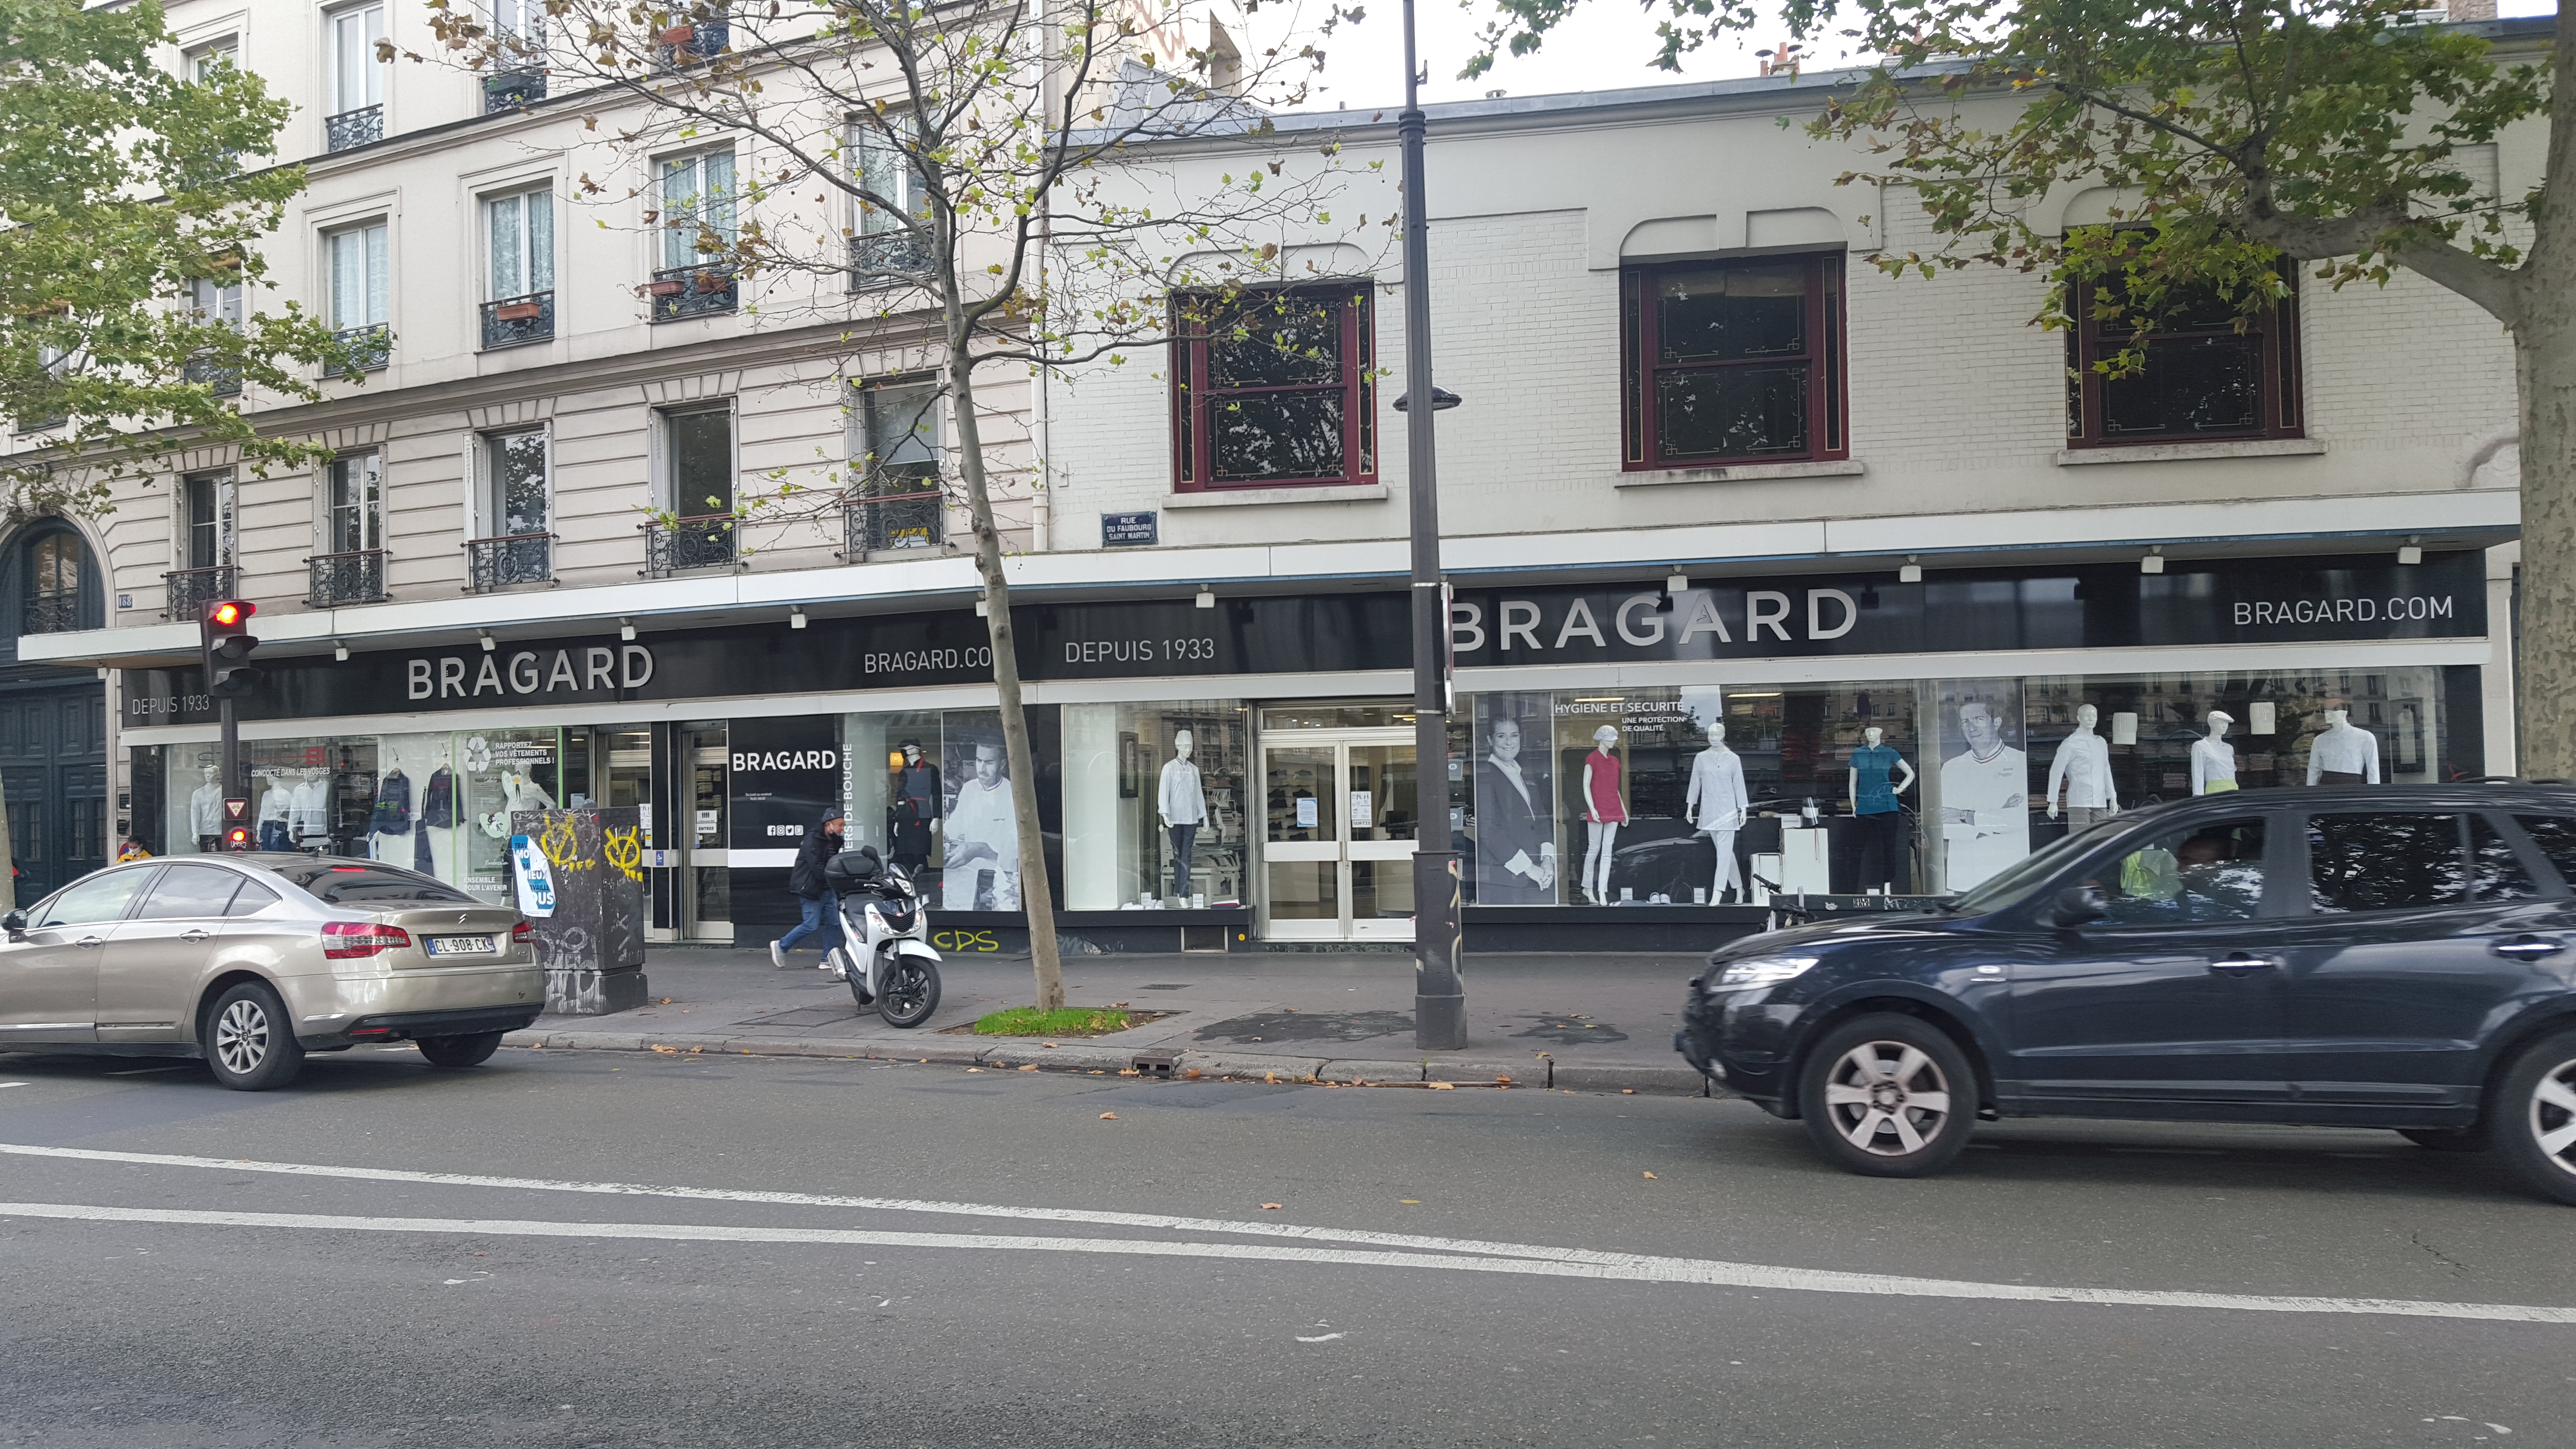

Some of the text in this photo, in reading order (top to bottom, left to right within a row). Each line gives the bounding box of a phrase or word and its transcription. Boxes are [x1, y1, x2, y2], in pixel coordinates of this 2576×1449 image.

[1117, 524, 1152, 532] FAUBOURG
[119, 596, 131, 606] 188
[2234, 596, 2452, 625] BRAGARD.COM
[1451, 588, 1857, 652] BRAGARD
[865, 646, 991, 673] BRAGARD.CO
[1066, 638, 1214, 662] DEPUIS 1933
[408, 645, 653, 699] BRAGARD
[132, 694, 209, 715] DEPUIS 1933
[1555, 703, 1608, 713] HYGIENE
[1610, 703, 1625, 712] ET
[509, 749, 547, 757] VÊTEMENTS
[733, 750, 836, 772] BRAGARD
[251, 767, 280, 777] CONCOCTÉ
[308, 767, 330, 775] VOSGES
[843, 743, 853, 800] BOUCHE
[843, 804, 853, 821] DE
[933, 930, 999, 951] CDS
